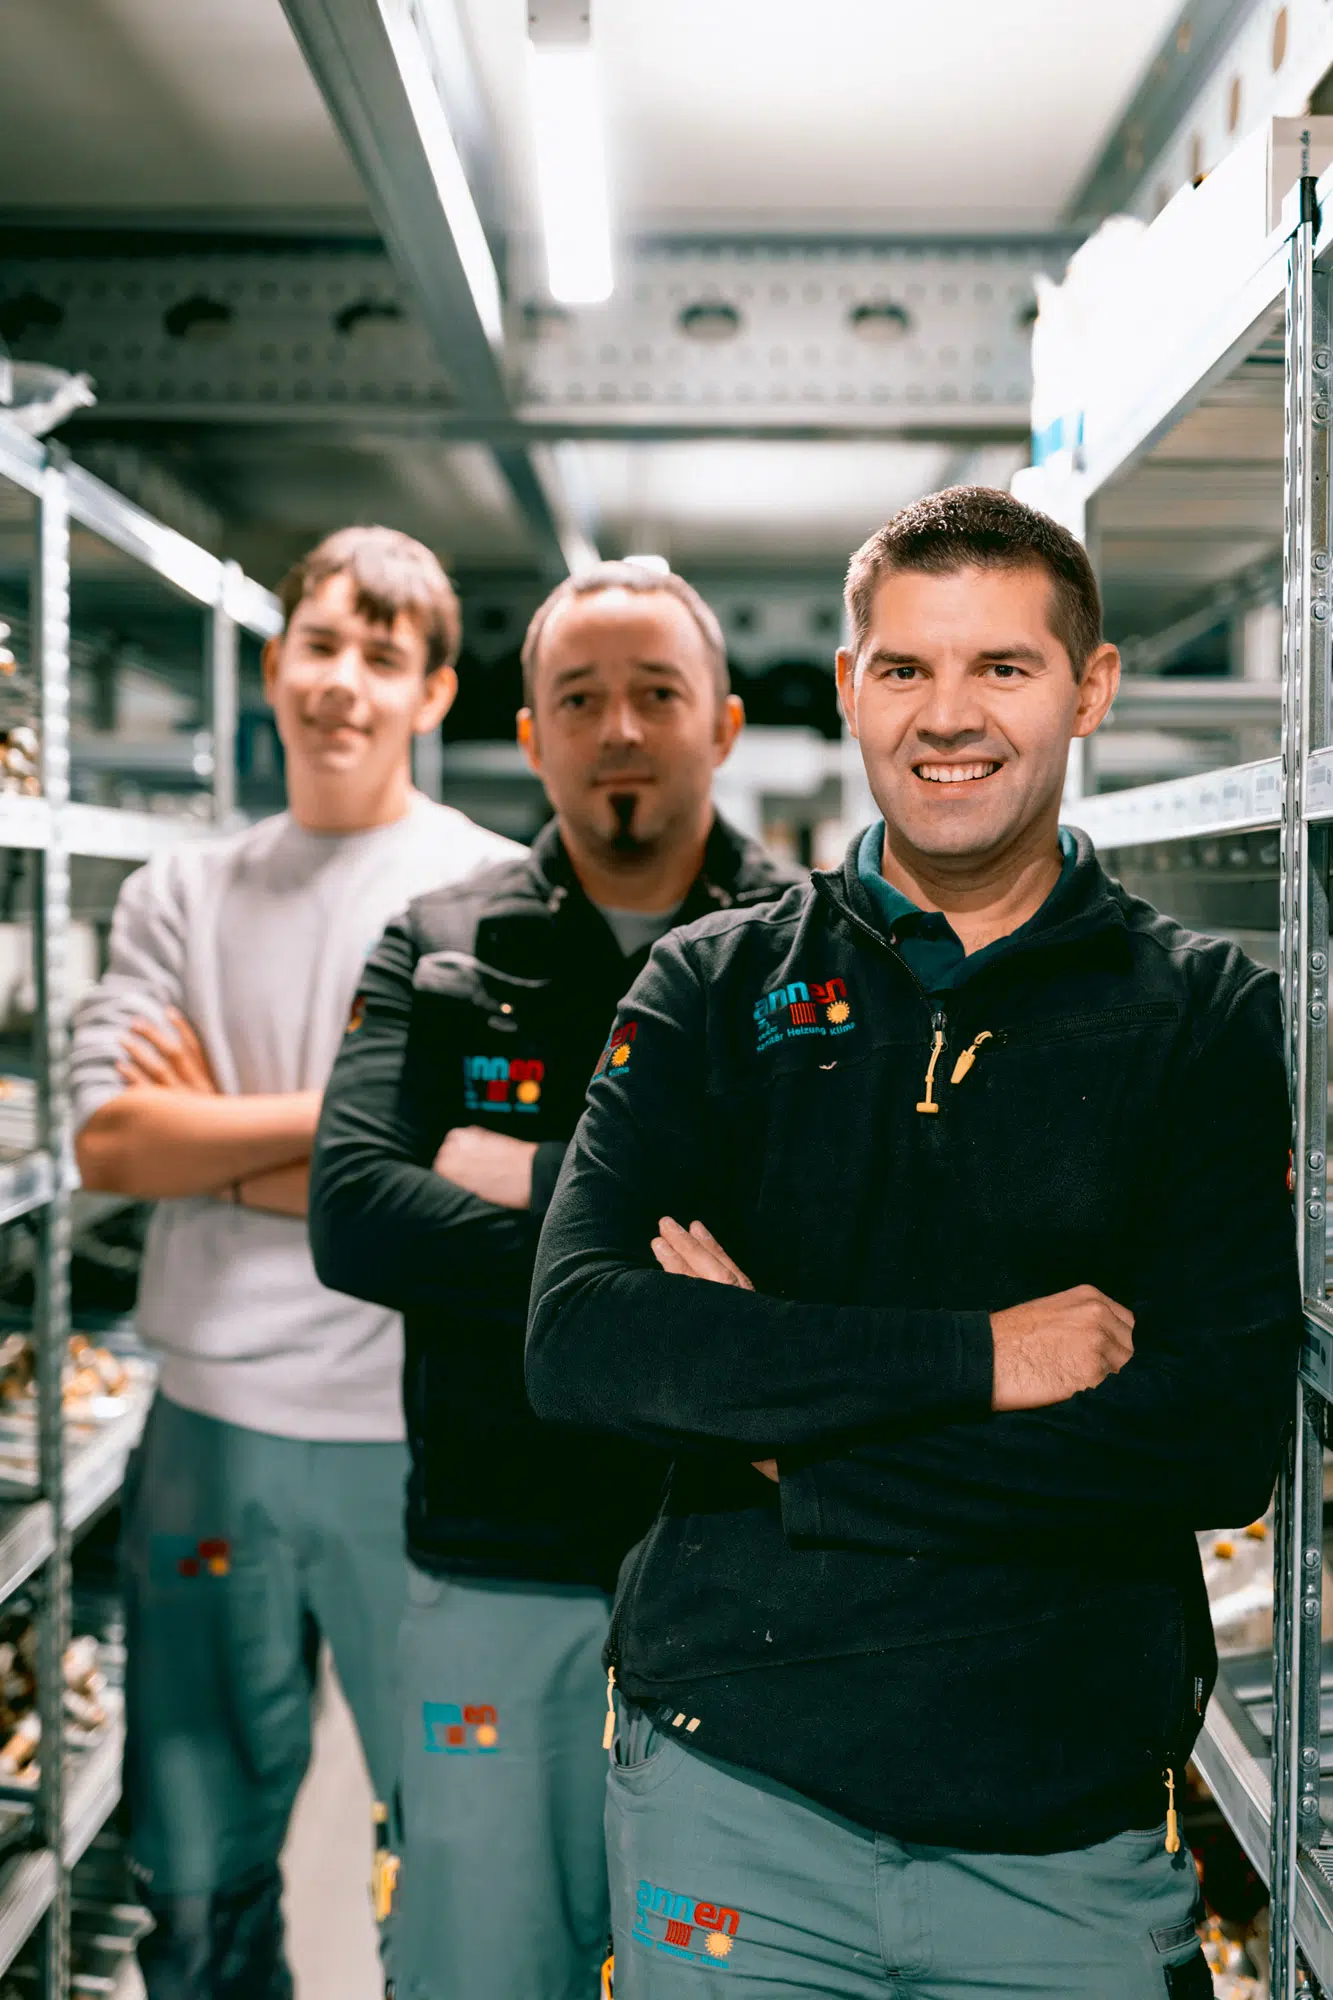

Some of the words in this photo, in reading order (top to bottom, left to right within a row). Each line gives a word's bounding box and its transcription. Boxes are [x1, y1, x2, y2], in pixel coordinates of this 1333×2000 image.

[753, 977, 847, 1020] annen
[787, 1026, 827, 1036] Heizung
[636, 1879, 740, 1936] annen
